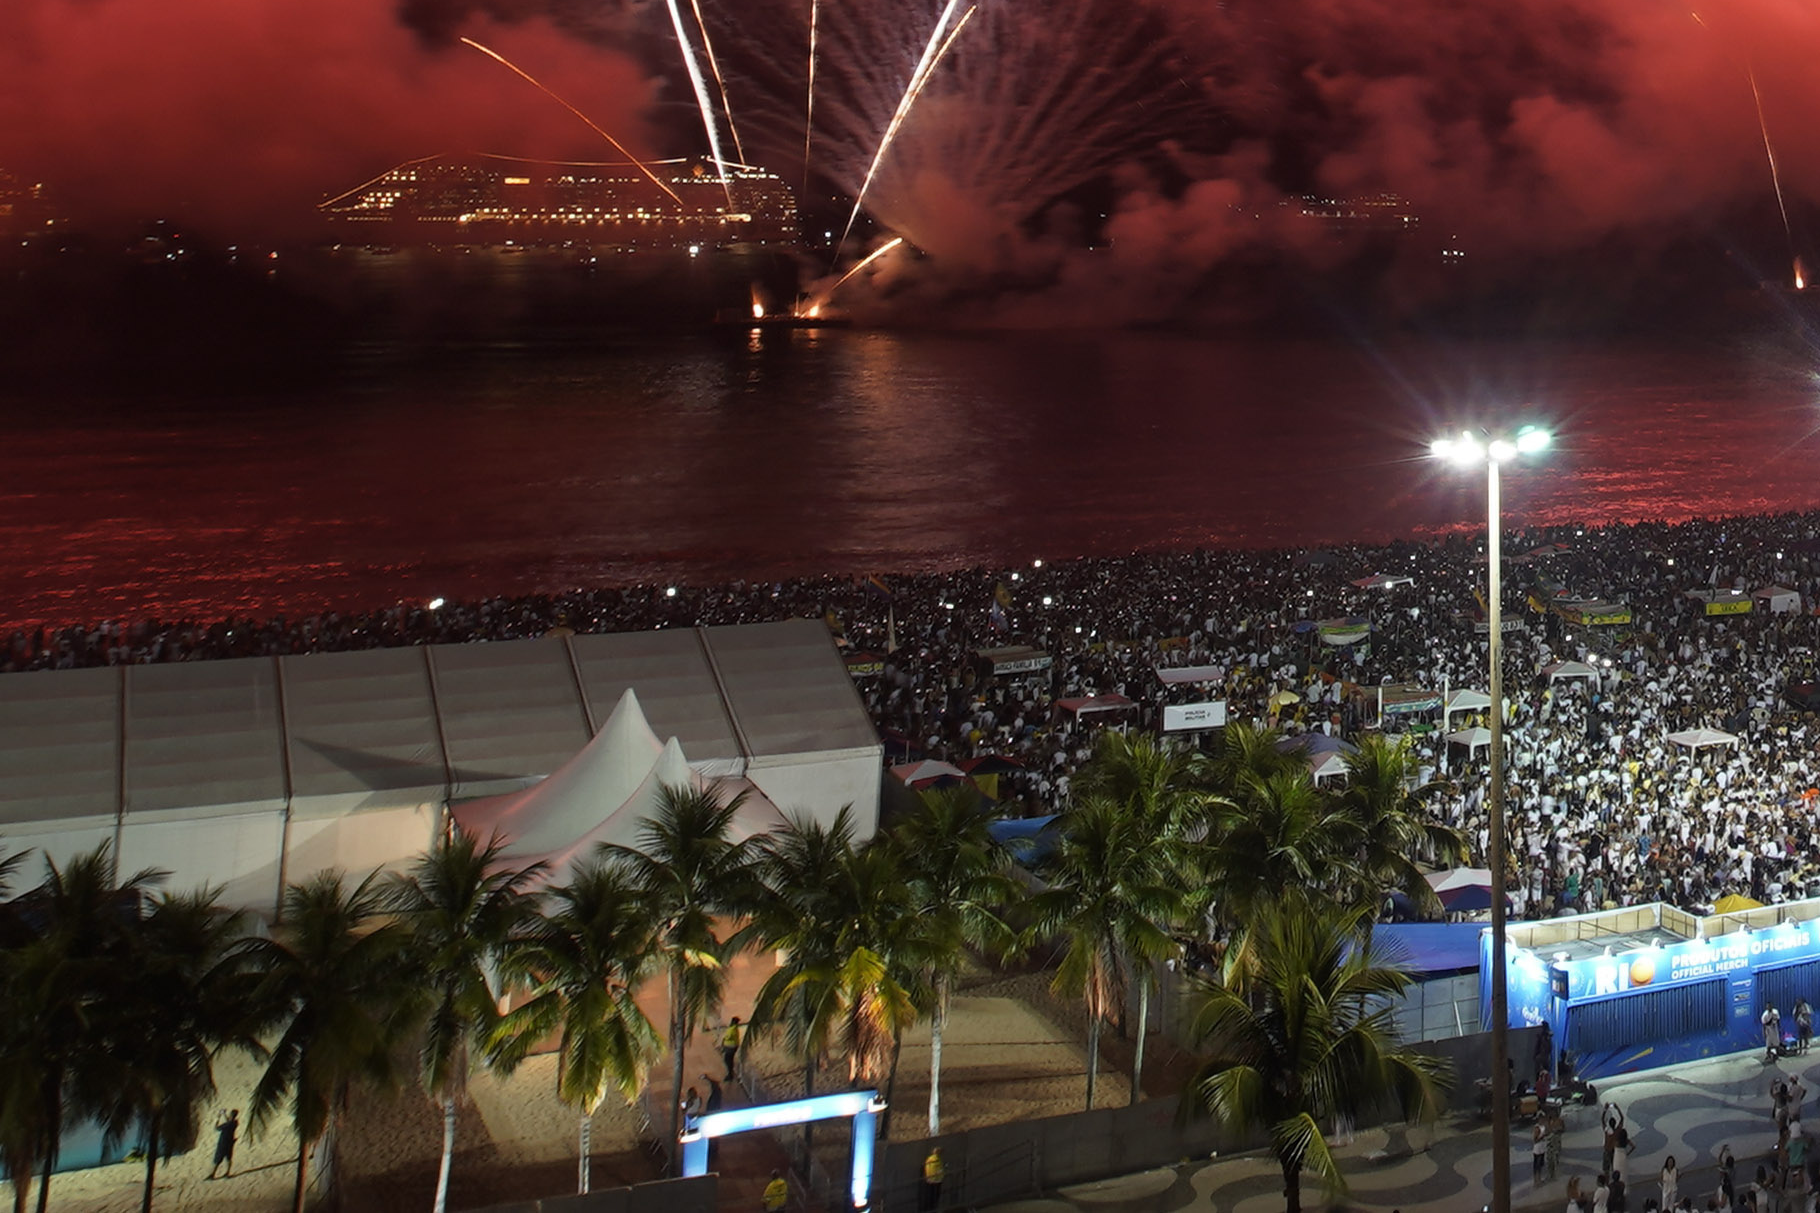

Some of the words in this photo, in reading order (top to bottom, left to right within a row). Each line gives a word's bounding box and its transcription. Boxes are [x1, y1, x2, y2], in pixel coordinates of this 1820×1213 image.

[1750, 932, 1810, 955] OFICIAIS
[1595, 955, 1656, 995] RIO
[1671, 963, 1715, 980] OFFICIAL
[1716, 958, 1749, 973] MERCH
